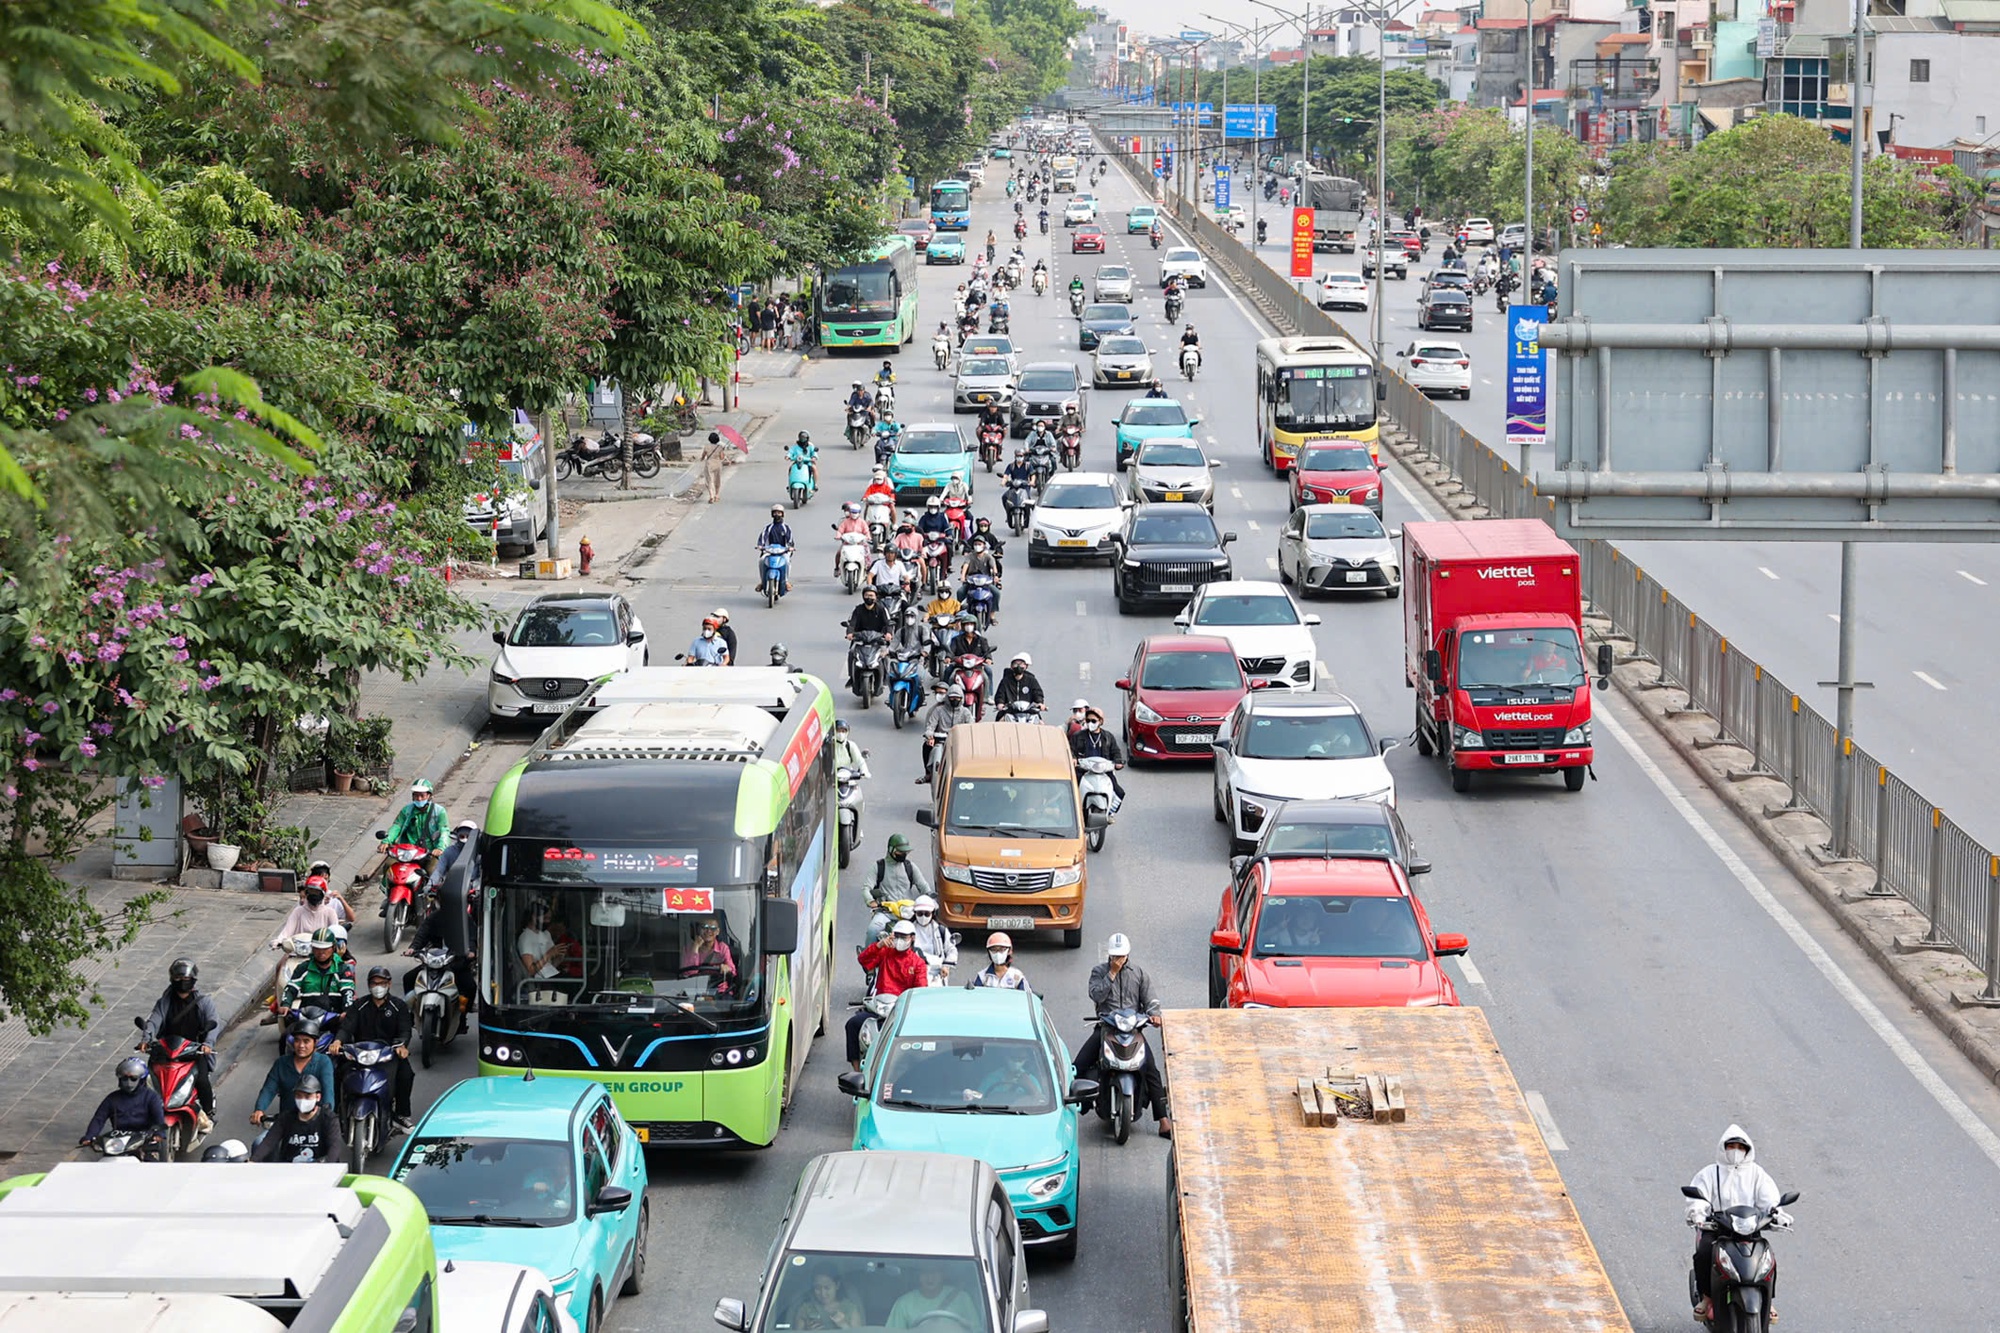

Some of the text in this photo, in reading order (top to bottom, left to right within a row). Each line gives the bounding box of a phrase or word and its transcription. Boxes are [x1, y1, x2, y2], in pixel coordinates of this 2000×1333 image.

[1515, 341, 1539, 354] 1-5
[1477, 565, 1535, 579] viettel
[1517, 579, 1536, 587] post
[1507, 697, 1540, 705] ISUZU
[1493, 711, 1554, 722] viettel post
[628, 1081, 684, 1093] GROUP
